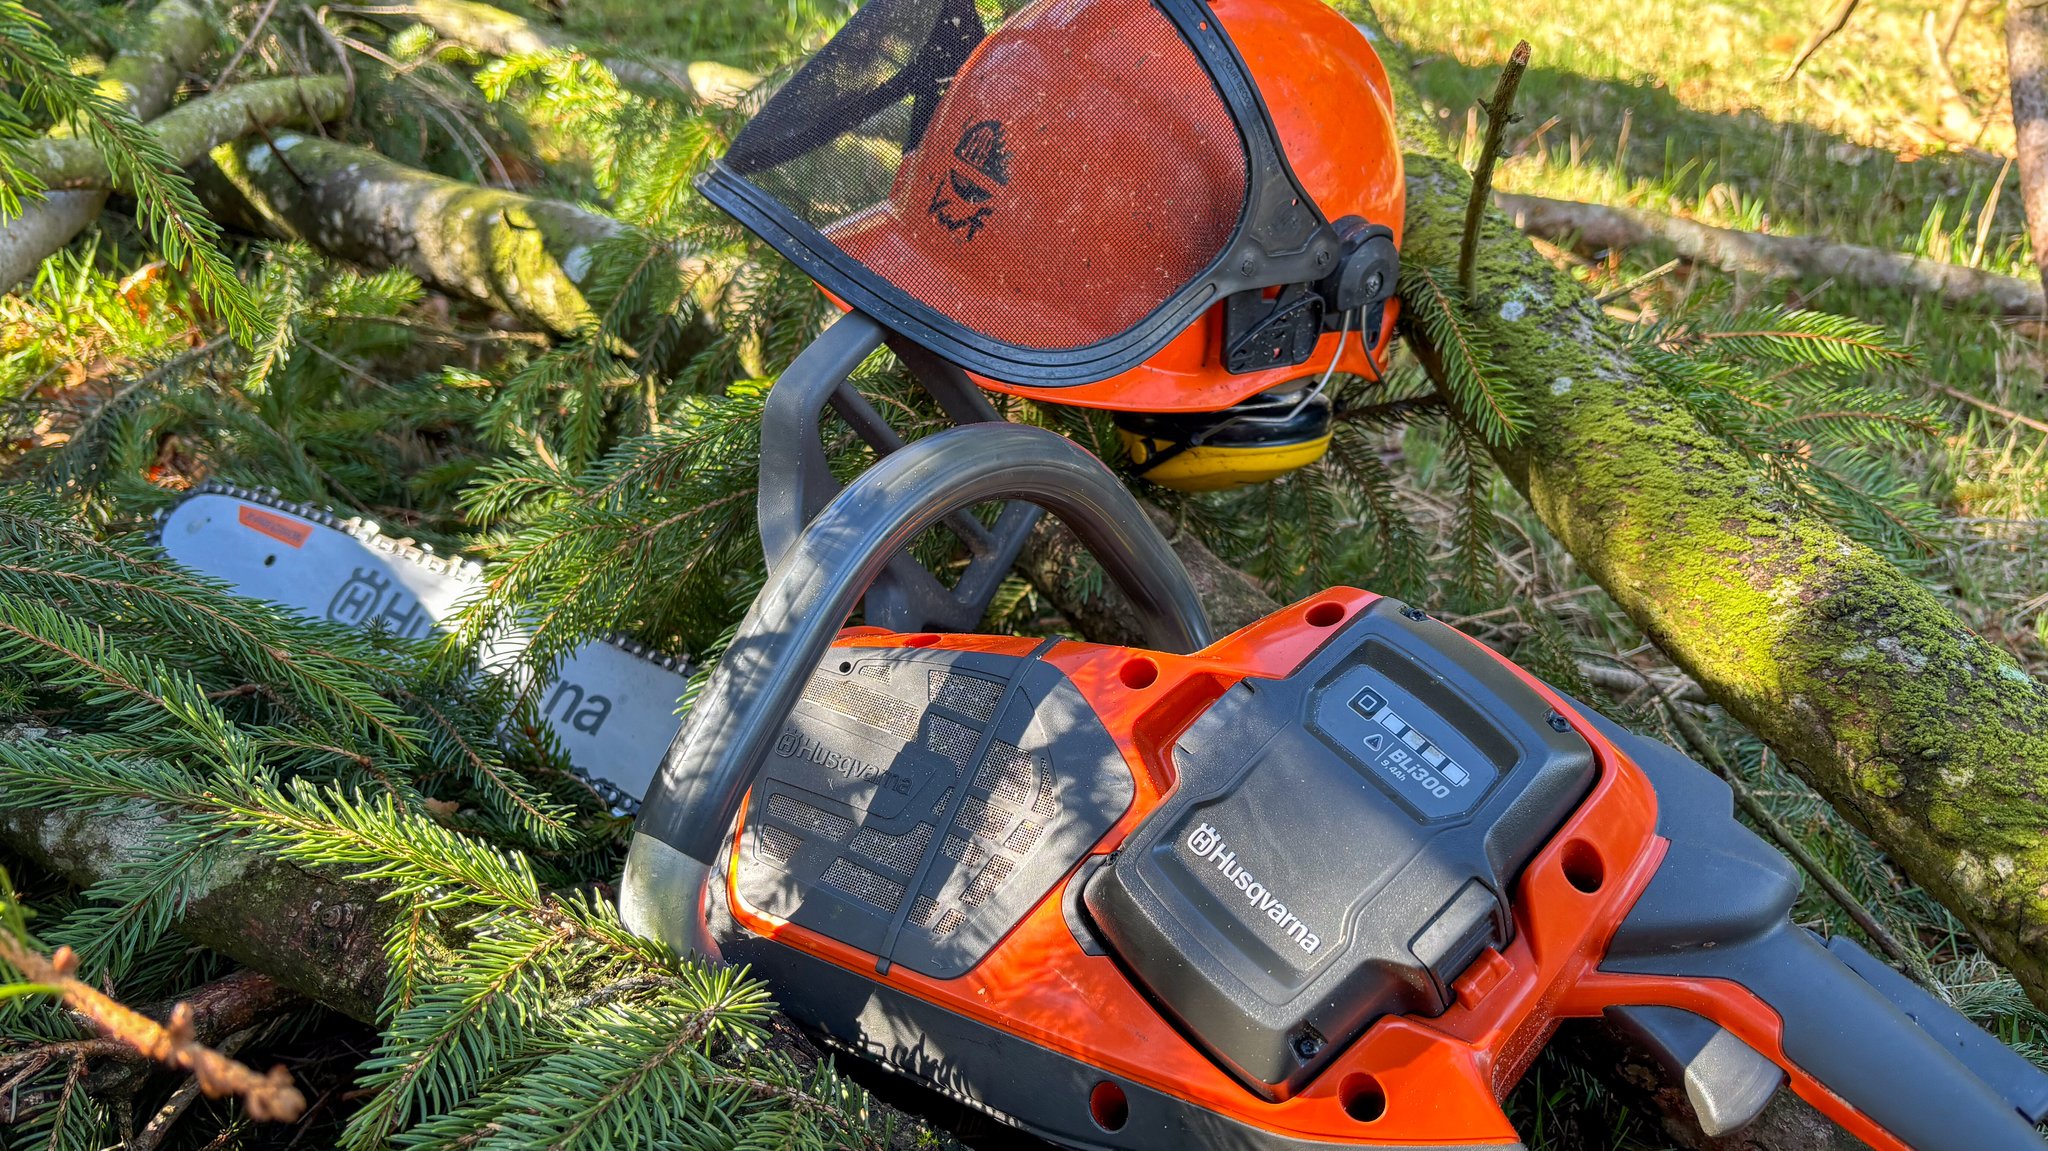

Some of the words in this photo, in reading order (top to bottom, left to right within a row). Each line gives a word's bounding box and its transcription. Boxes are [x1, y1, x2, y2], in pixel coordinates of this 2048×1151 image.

[797, 737, 914, 796] Husqvarna
[1387, 748, 1450, 799] BLi300
[1208, 842, 1321, 955] Husqvarna
